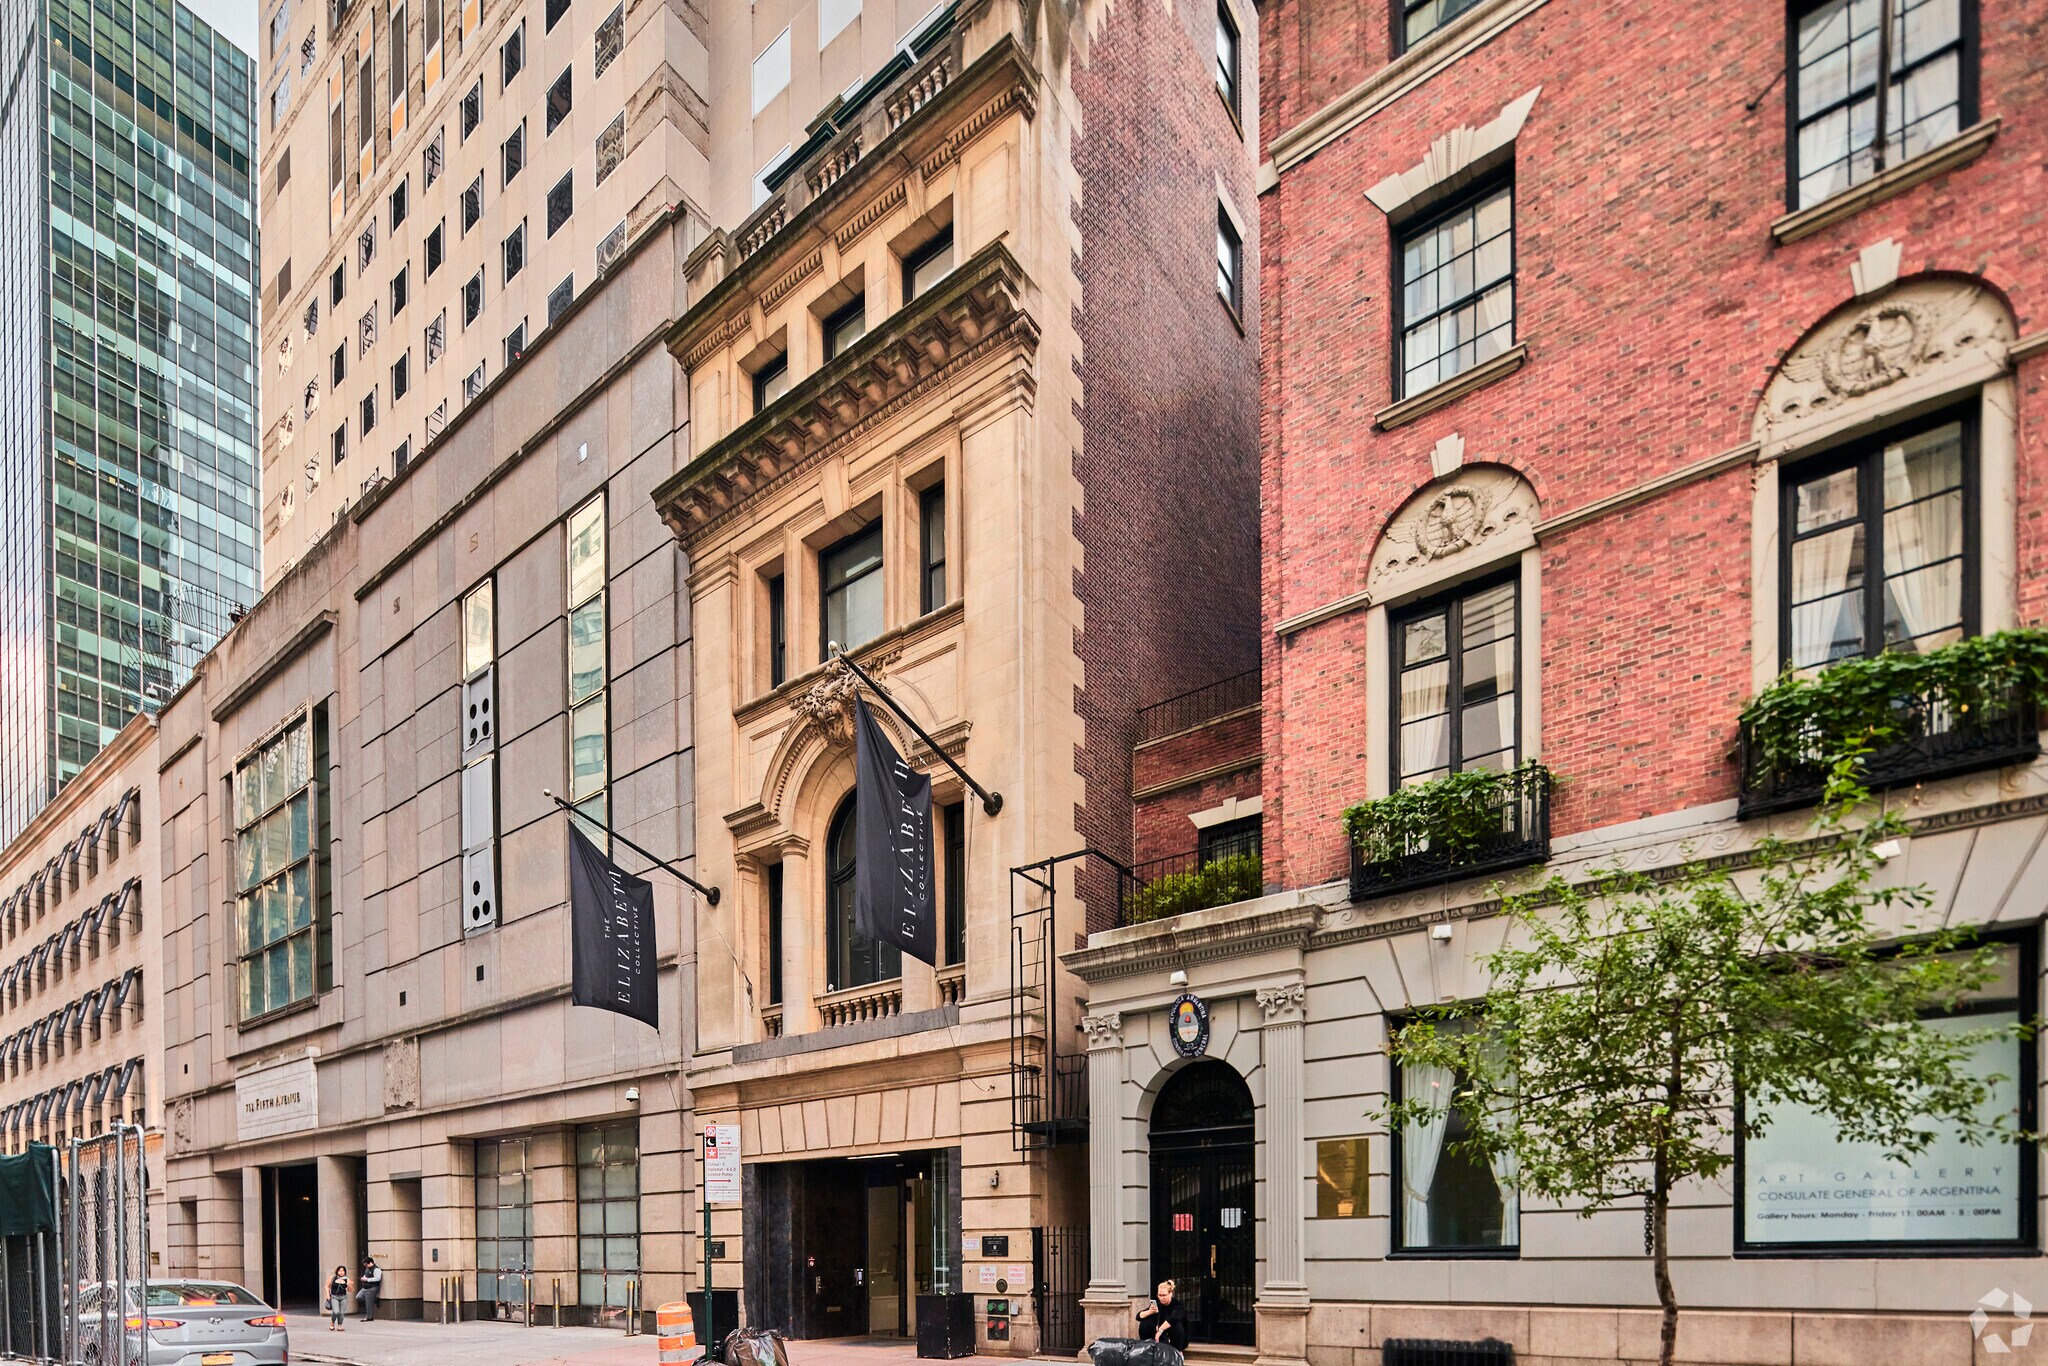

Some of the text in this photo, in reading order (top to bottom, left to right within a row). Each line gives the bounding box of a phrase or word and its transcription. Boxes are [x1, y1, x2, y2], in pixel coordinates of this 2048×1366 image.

[894, 760, 916, 938] ELIZABEH
[608, 870, 631, 1004] ELIZABETH
[632, 906, 641, 975] COLLECTIVE
[1758, 1167, 2001, 1184] ART GALLERY
[1758, 1185, 2001, 1201] CONSULATE GENERAL OF ARGENTINA
[1757, 1212, 1788, 1220] Gallery
[1820, 1210, 1858, 1219] Monday
[1868, 1209, 1896, 1218] Friday
